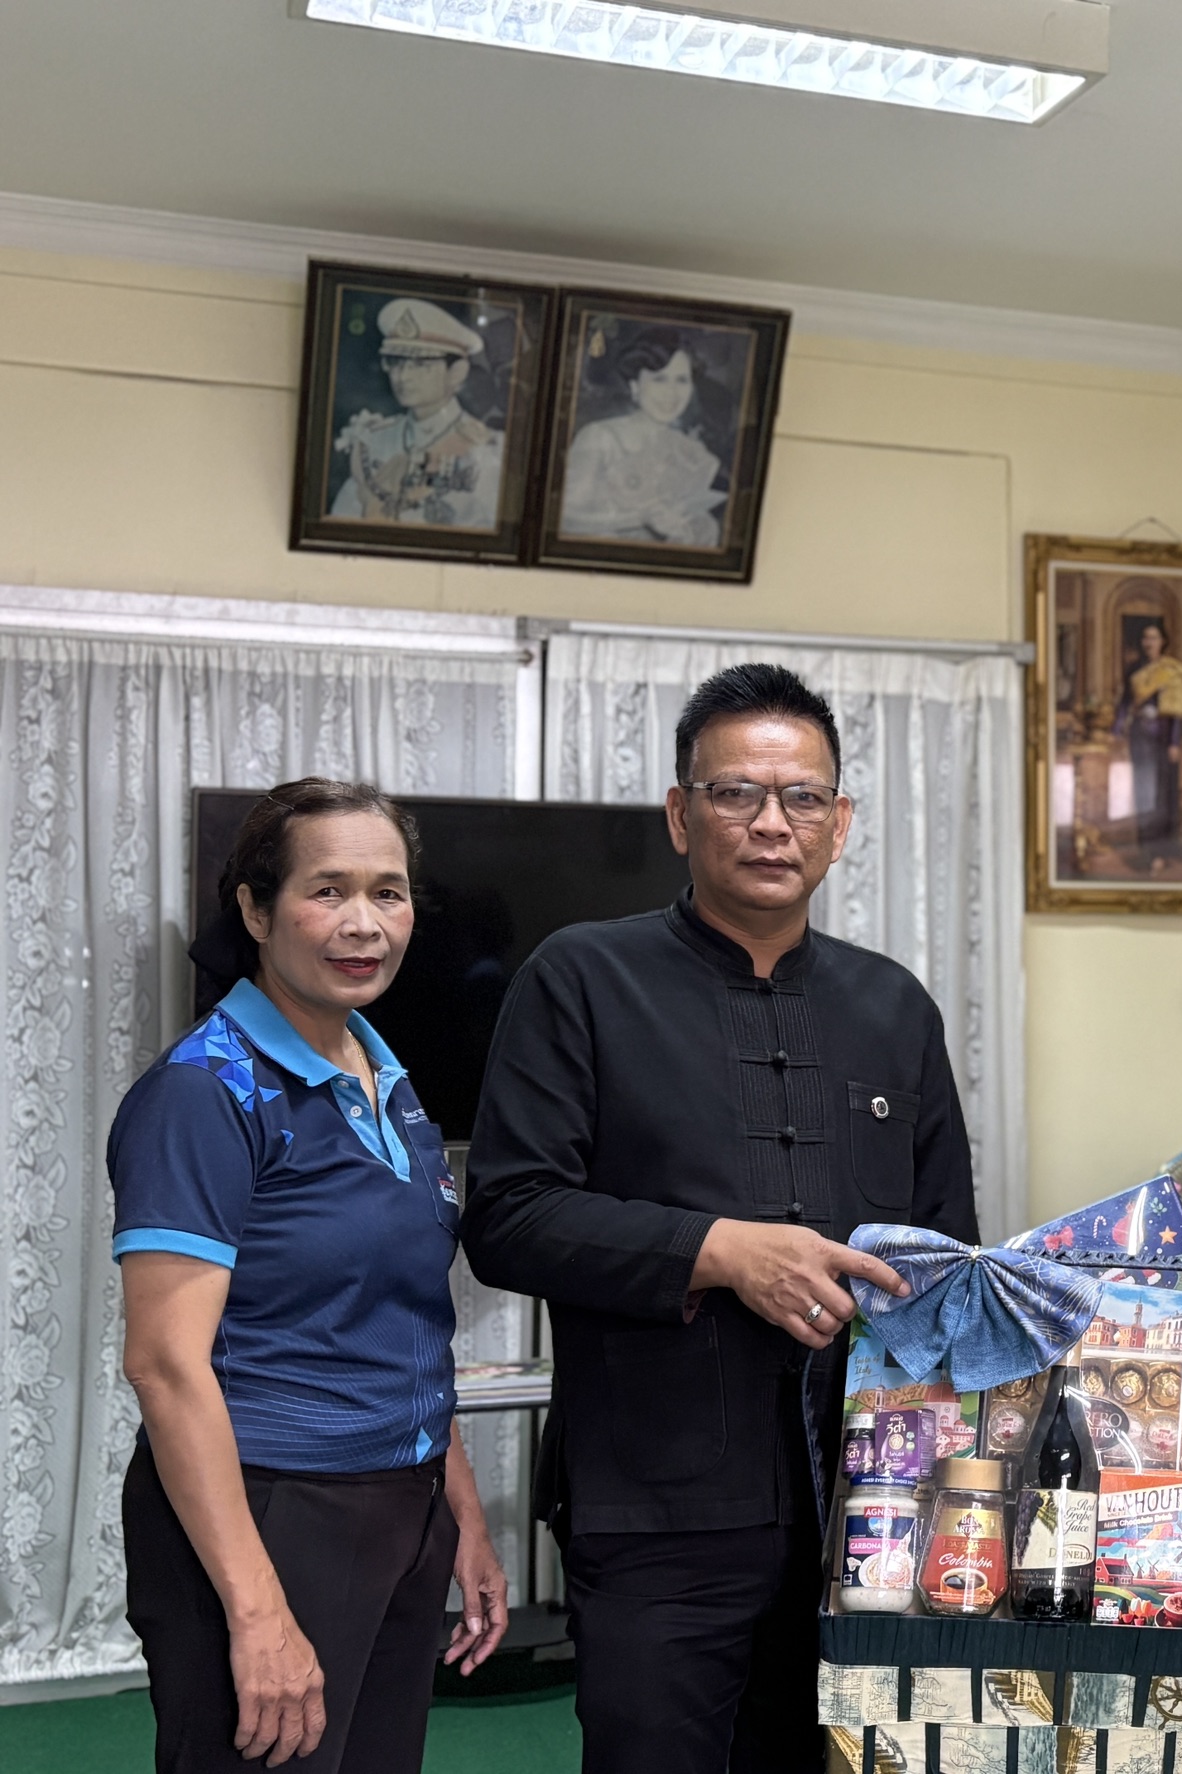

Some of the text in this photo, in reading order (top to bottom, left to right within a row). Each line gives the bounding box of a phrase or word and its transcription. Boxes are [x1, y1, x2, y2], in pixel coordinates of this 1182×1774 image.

[1084, 1411, 1122, 1428] RERO
[1090, 1427, 1117, 1438] CTION
[1074, 1498, 1096, 1512] Red
[1064, 1506, 1092, 1525] Grape
[1063, 1520, 1089, 1535] Juice
[1103, 1521, 1118, 1529] Milk
[938, 1552, 993, 1568] Colombia
[1048, 1547, 1093, 1560] DNELLI
